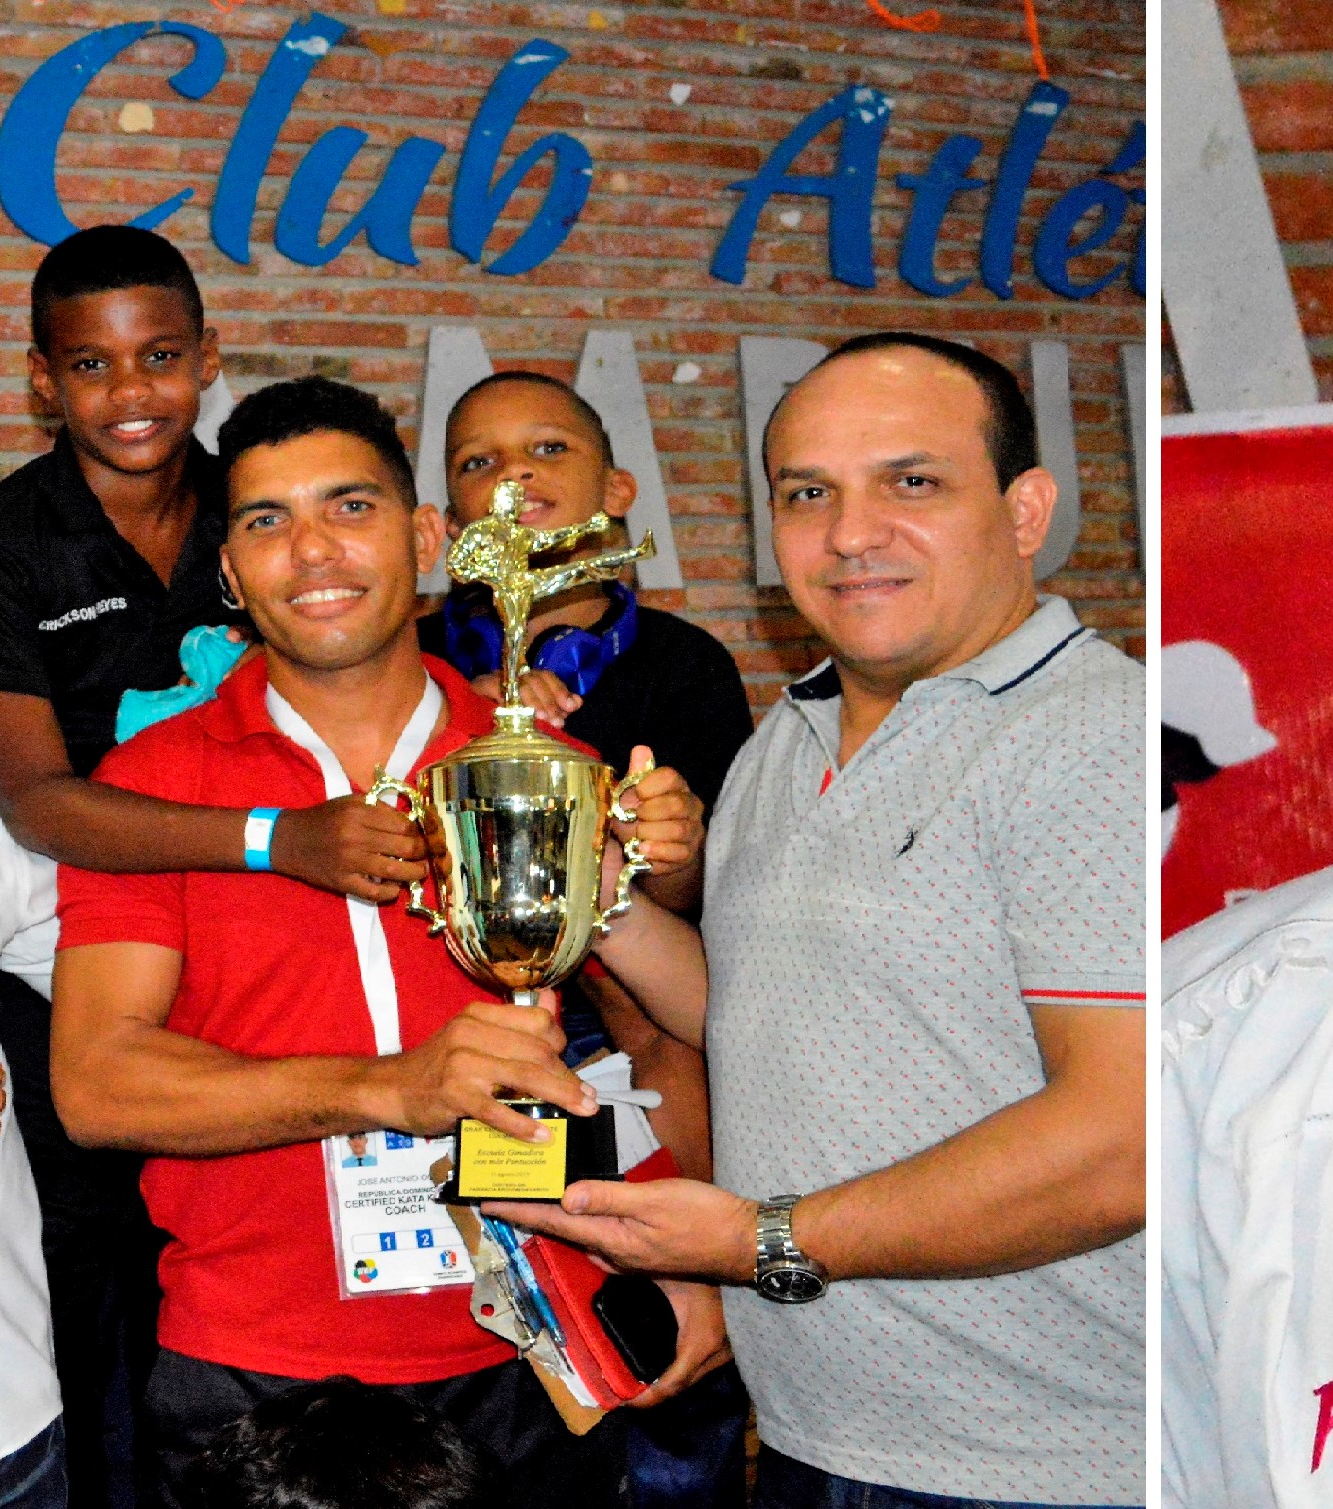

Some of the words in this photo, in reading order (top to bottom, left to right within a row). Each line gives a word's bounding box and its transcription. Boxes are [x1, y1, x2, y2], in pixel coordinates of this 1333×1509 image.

[707, 81, 1146, 300] Atlé
[345, 1197, 396, 1208] CERTIFIED
[398, 1194, 425, 1204] KATA
[385, 1204, 426, 1215] COACH
[419, 1233, 431, 1247] 2
